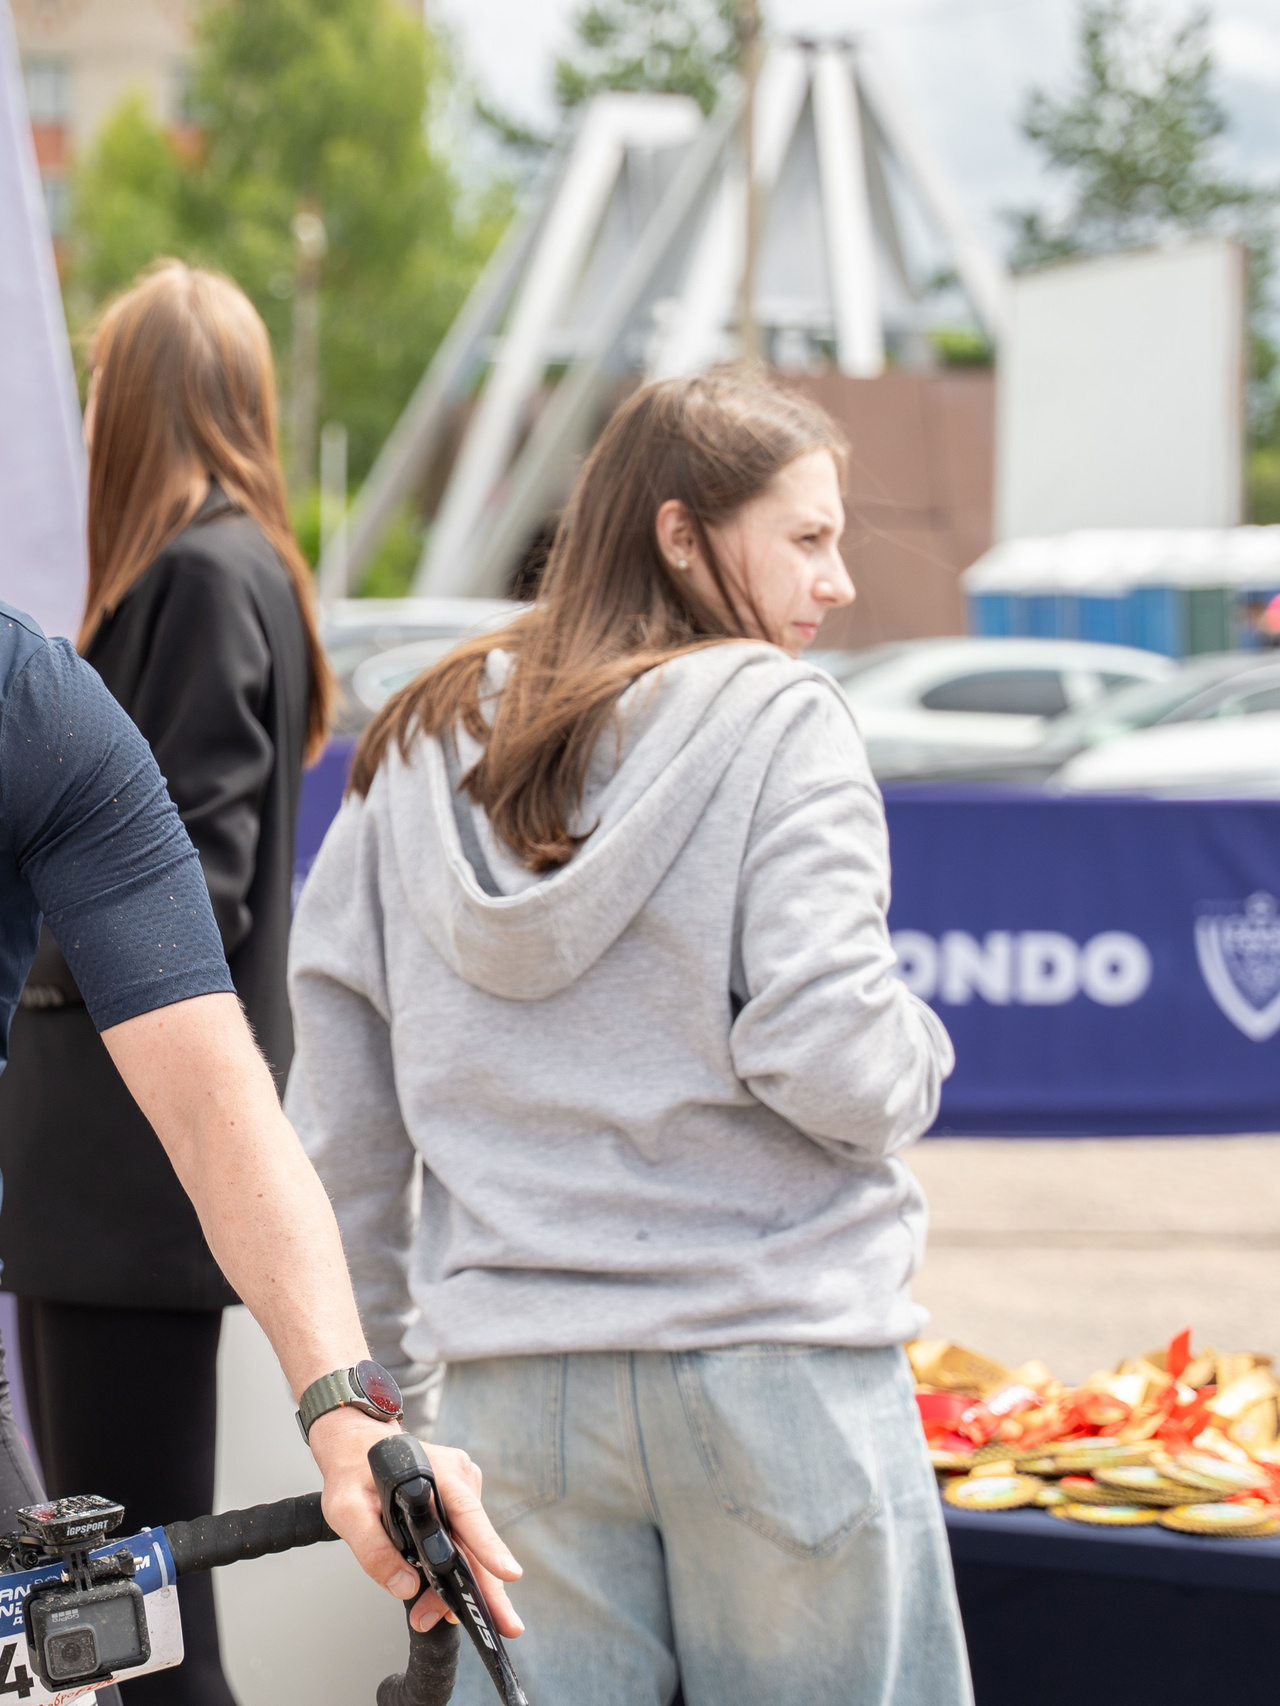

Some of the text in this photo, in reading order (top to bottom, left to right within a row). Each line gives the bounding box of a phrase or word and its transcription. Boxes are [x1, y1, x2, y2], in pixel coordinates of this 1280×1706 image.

[892, 929, 1152, 1006] ONDO
[66, 1520, 109, 1537] iGPSPORT
[461, 1591, 497, 1651] 105
